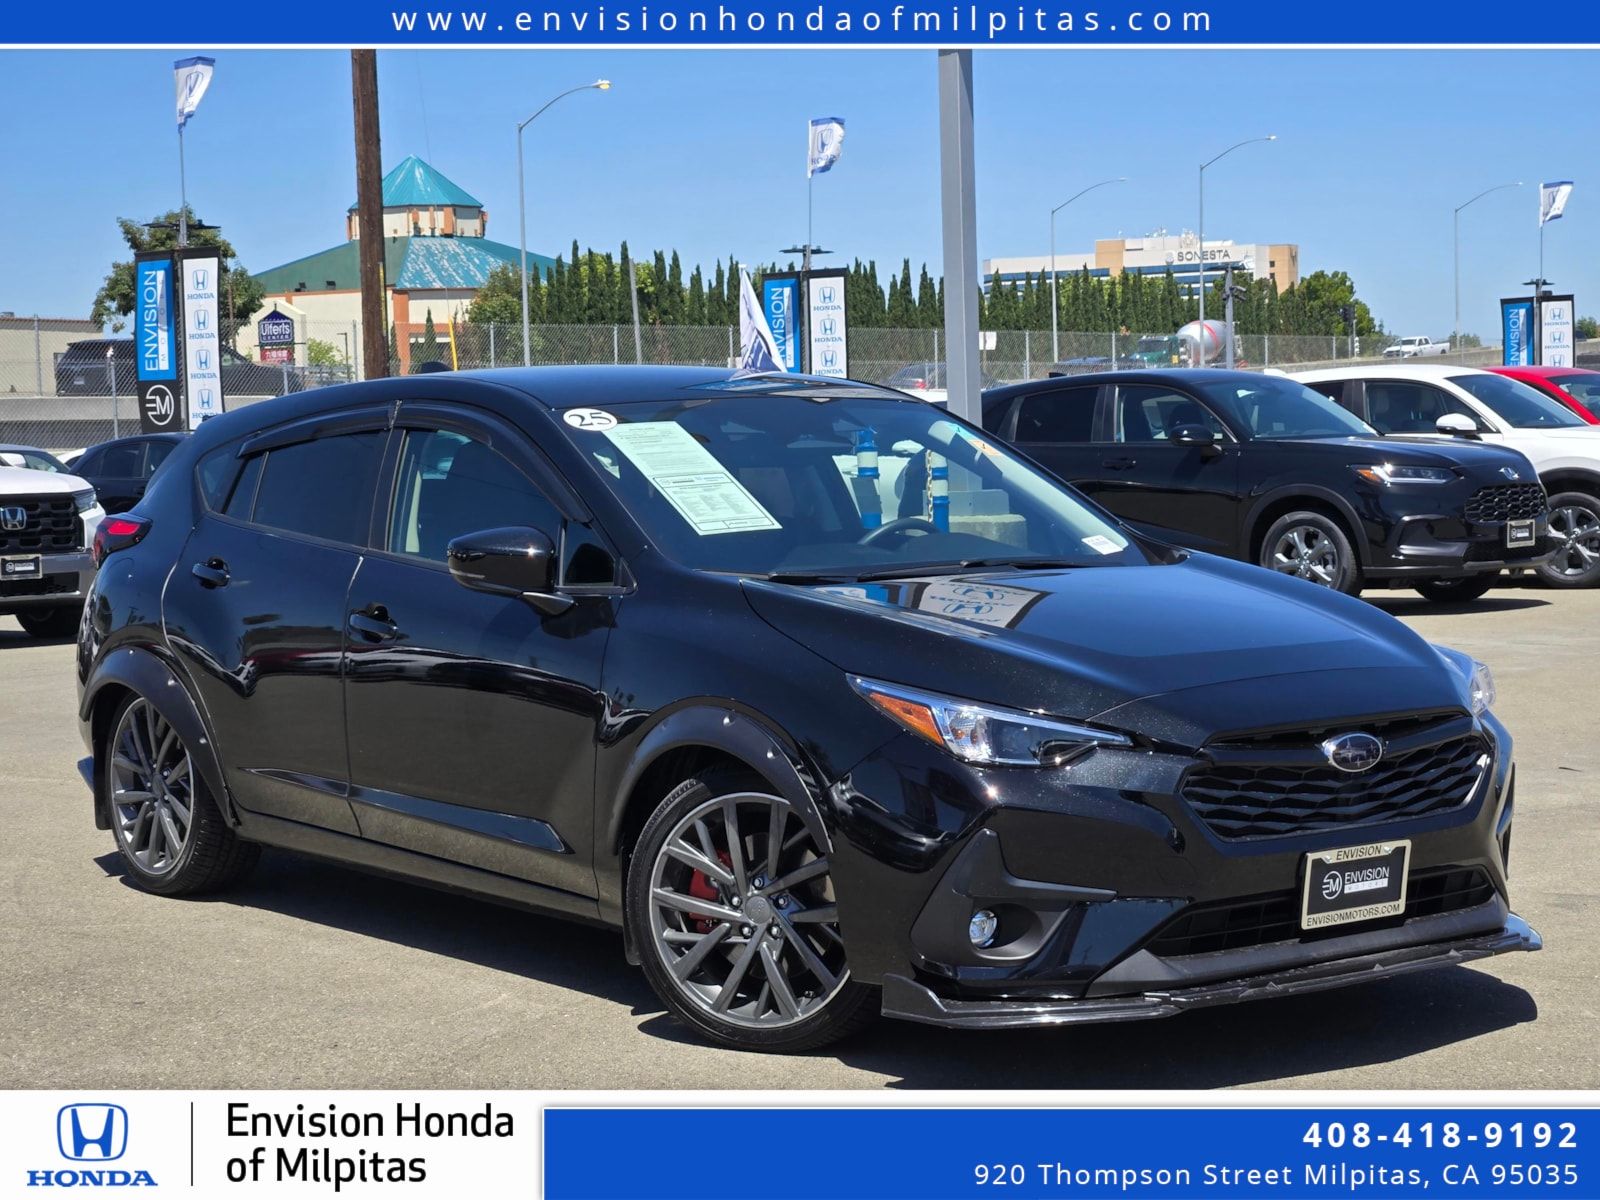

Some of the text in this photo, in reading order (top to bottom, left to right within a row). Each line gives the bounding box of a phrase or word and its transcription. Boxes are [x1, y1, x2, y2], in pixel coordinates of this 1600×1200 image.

[1177, 249, 1231, 261] SONESTA
[144, 270, 159, 370] ENVISION
[568, 412, 612, 427] 25
[1336, 845, 1382, 861] ENVISION
[1344, 866, 1390, 884] ENVISION
[1306, 903, 1401, 927] ENVISIONMOTORS.COM
